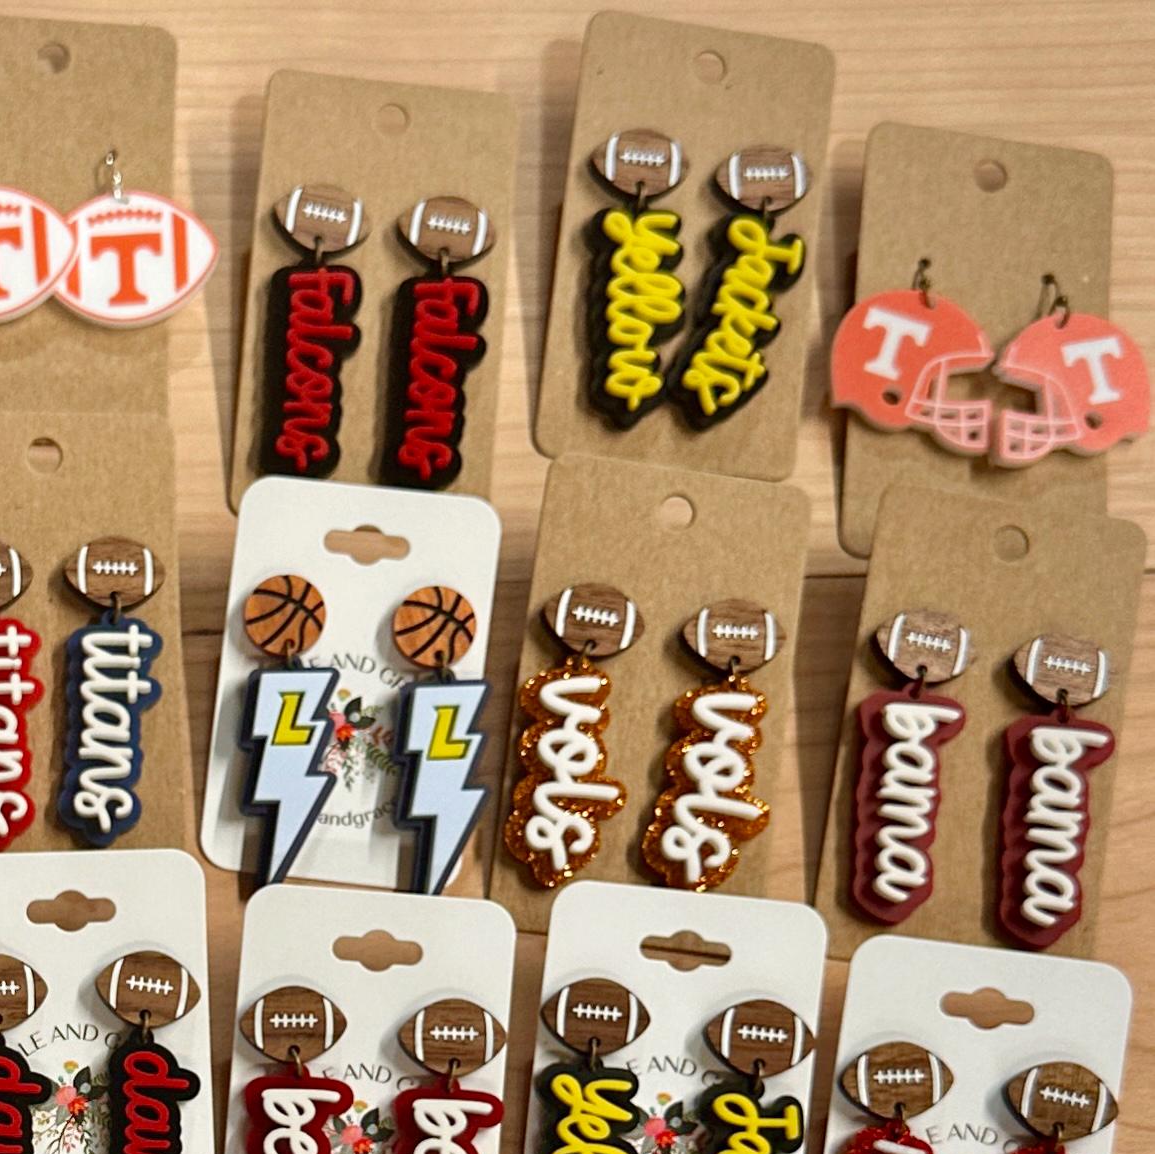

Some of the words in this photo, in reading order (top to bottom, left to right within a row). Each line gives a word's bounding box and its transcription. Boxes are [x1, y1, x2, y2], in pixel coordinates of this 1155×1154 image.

[90, 232, 162, 307] T
[602, 210, 685, 410] Yellow
[683, 216, 803, 416] Jackets
[862, 306, 933, 381] T
[276, 267, 355, 472] Falcons
[399, 277, 479, 479] Falcons
[1061, 336, 1125, 406] T
[328, 653, 377, 674] AND
[73, 624, 153, 833] titans
[270, 691, 315, 746] L
[425, 704, 471, 761] L
[526, 676, 622, 873] vols
[660, 693, 766, 883] vols
[873, 702, 962, 901] bama
[1021, 727, 1111, 927] bama
[50, 1023, 99, 1044] AND
[647, 1055, 698, 1077] AND
[343, 1062, 393, 1085] AND
[946, 1122, 999, 1146] AND
